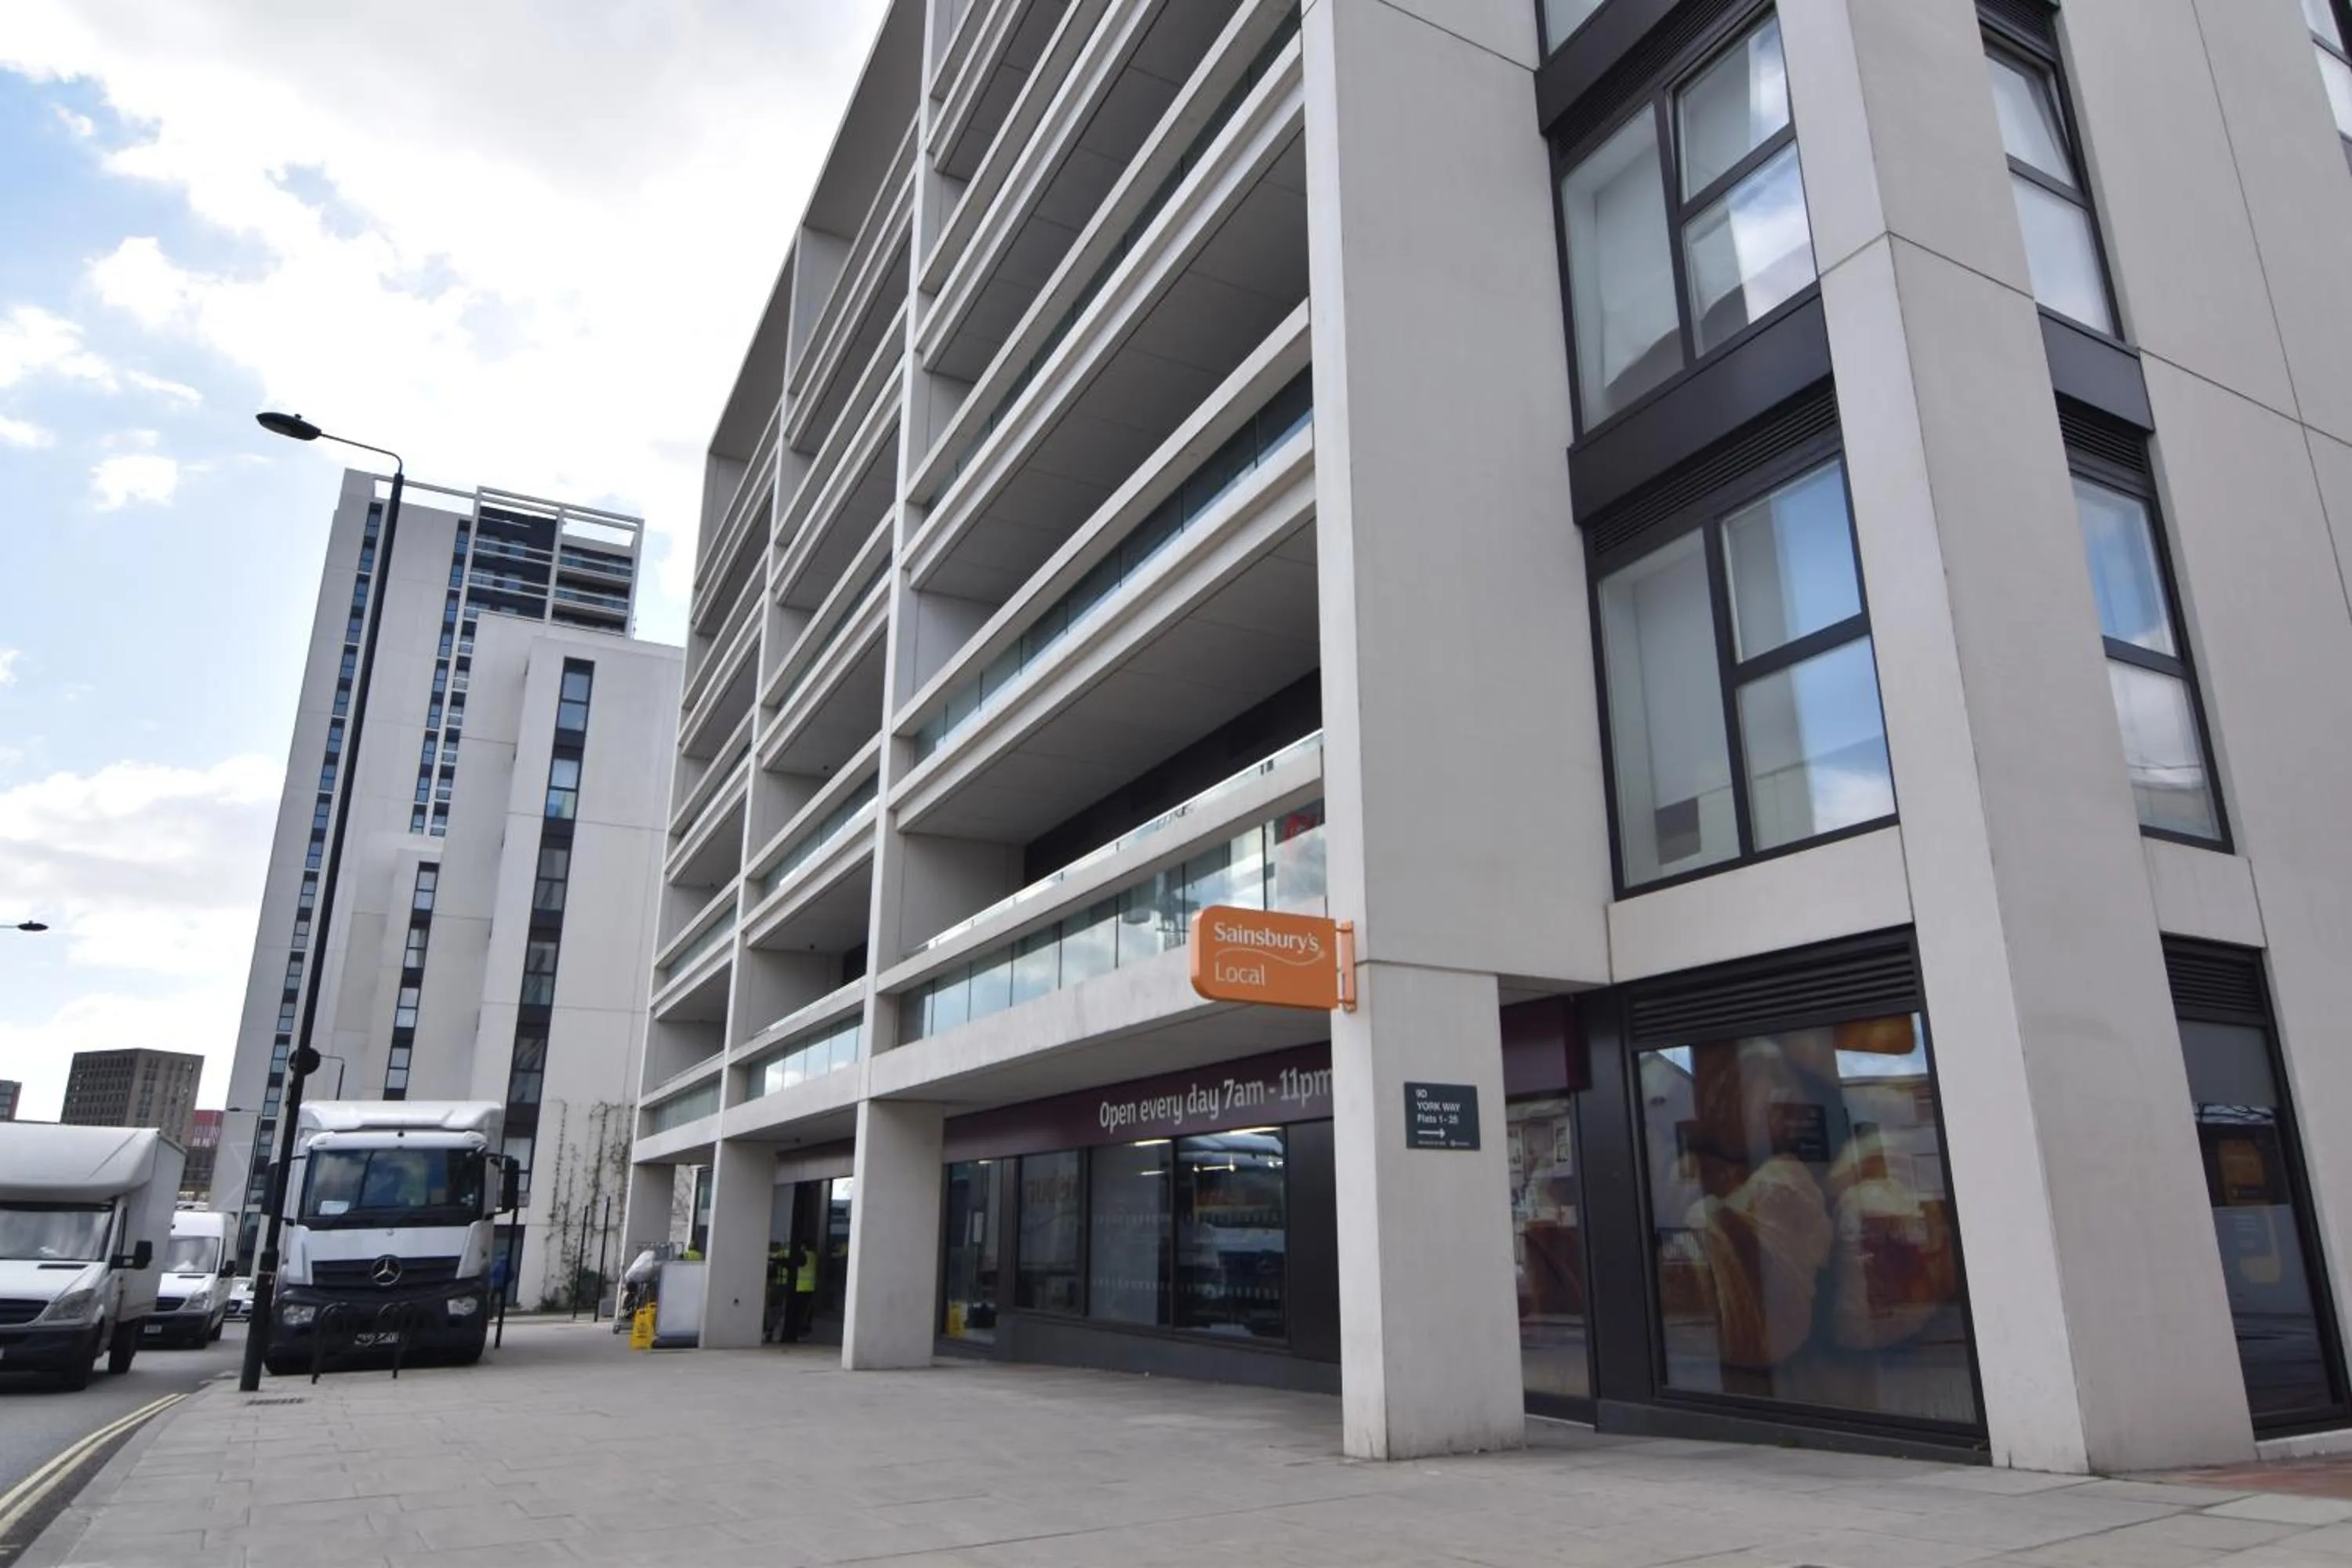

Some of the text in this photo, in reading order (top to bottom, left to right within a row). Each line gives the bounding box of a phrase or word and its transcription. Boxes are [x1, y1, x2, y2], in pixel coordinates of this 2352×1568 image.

[1214, 921, 1319, 954] Sainsbury's
[1214, 962, 1265, 986] Local
[1099, 1101, 1136, 1134] Open
[1140, 1094, 1182, 1126] every
[1187, 1082, 1220, 1120] day
[1224, 1078, 1265, 1110] 7am
[1279, 1066, 1333, 1108] 11pm
[1417, 1101, 1461, 1112] YORK WAY
